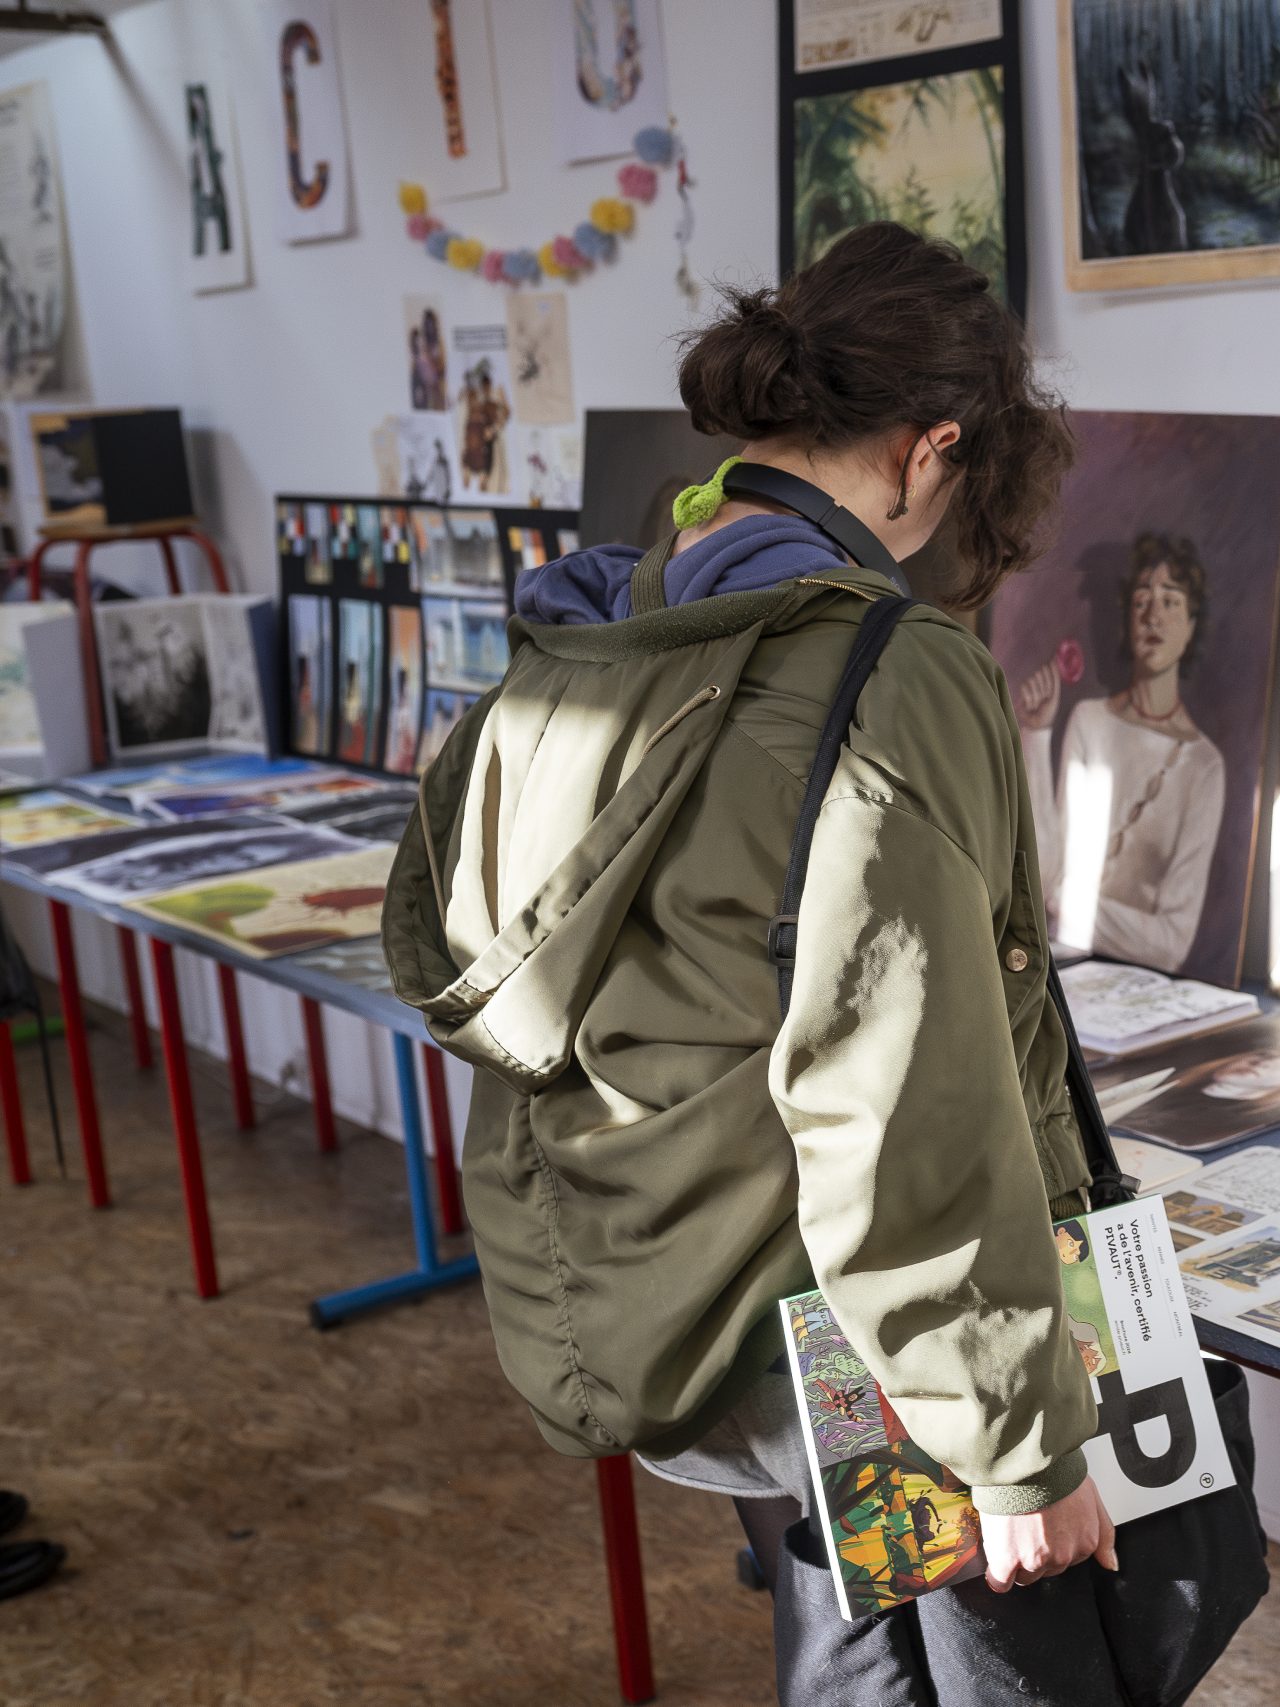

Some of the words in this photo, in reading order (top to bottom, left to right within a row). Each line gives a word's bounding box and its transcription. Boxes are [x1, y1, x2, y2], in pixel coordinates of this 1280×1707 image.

[1116, 1223, 1124, 1231] a
[1118, 1232, 1128, 1249] de
[1130, 1219, 1141, 1252] Votre
[1135, 1251, 1153, 1298] passion
[1134, 1299, 1153, 1342] certifié
